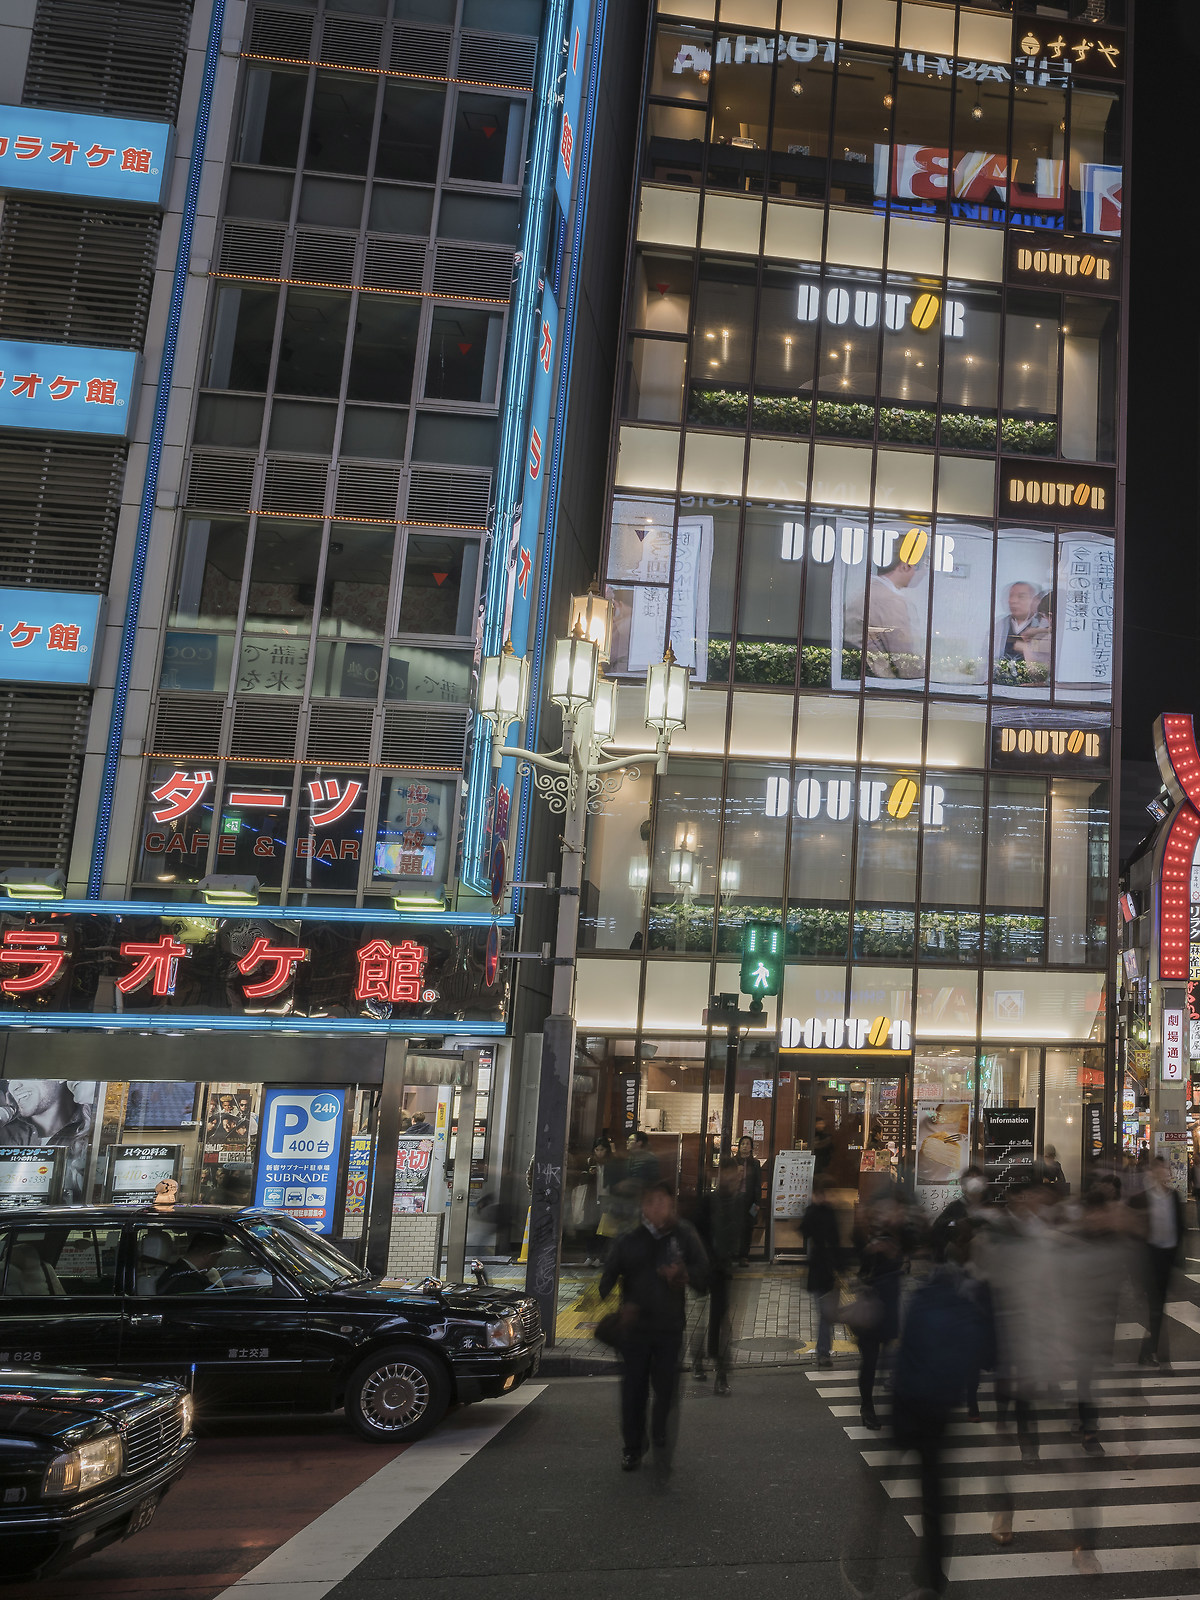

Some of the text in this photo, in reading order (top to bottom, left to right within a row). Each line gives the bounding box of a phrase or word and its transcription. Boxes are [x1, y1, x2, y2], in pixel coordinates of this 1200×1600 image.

[1046, 34, 1120, 68] すずや
[0, 134, 152, 174] ラオケ館
[1017, 248, 1110, 281] DOUTOR
[797, 284, 967, 338] DOUTOR
[0, 372, 118, 406] オケ館
[1009, 478, 1106, 510] DOUTOR
[781, 521, 955, 573] DOUTOR
[0, 620, 81, 653] ケ館
[1000, 728, 1100, 758] DOUTOR
[152, 770, 362, 827] ダーツ
[765, 776, 944, 826] DOUTOR
[144, 832, 361, 860] CAFE & BAR
[400, 784, 429, 875] 投げ放題
[1, 929, 429, 1003] ラオケ館
[781, 1016, 911, 1051] DOUTOR
[1166, 1014, 1180, 1075] 劇場通り
[313, 1102, 337, 1113] 24h
[271, 1105, 309, 1153] P
[265, 1173, 329, 1183] SUBNADE
[13, 1351, 42, 1361] 628
[228, 1348, 269, 1359] 富士交通
